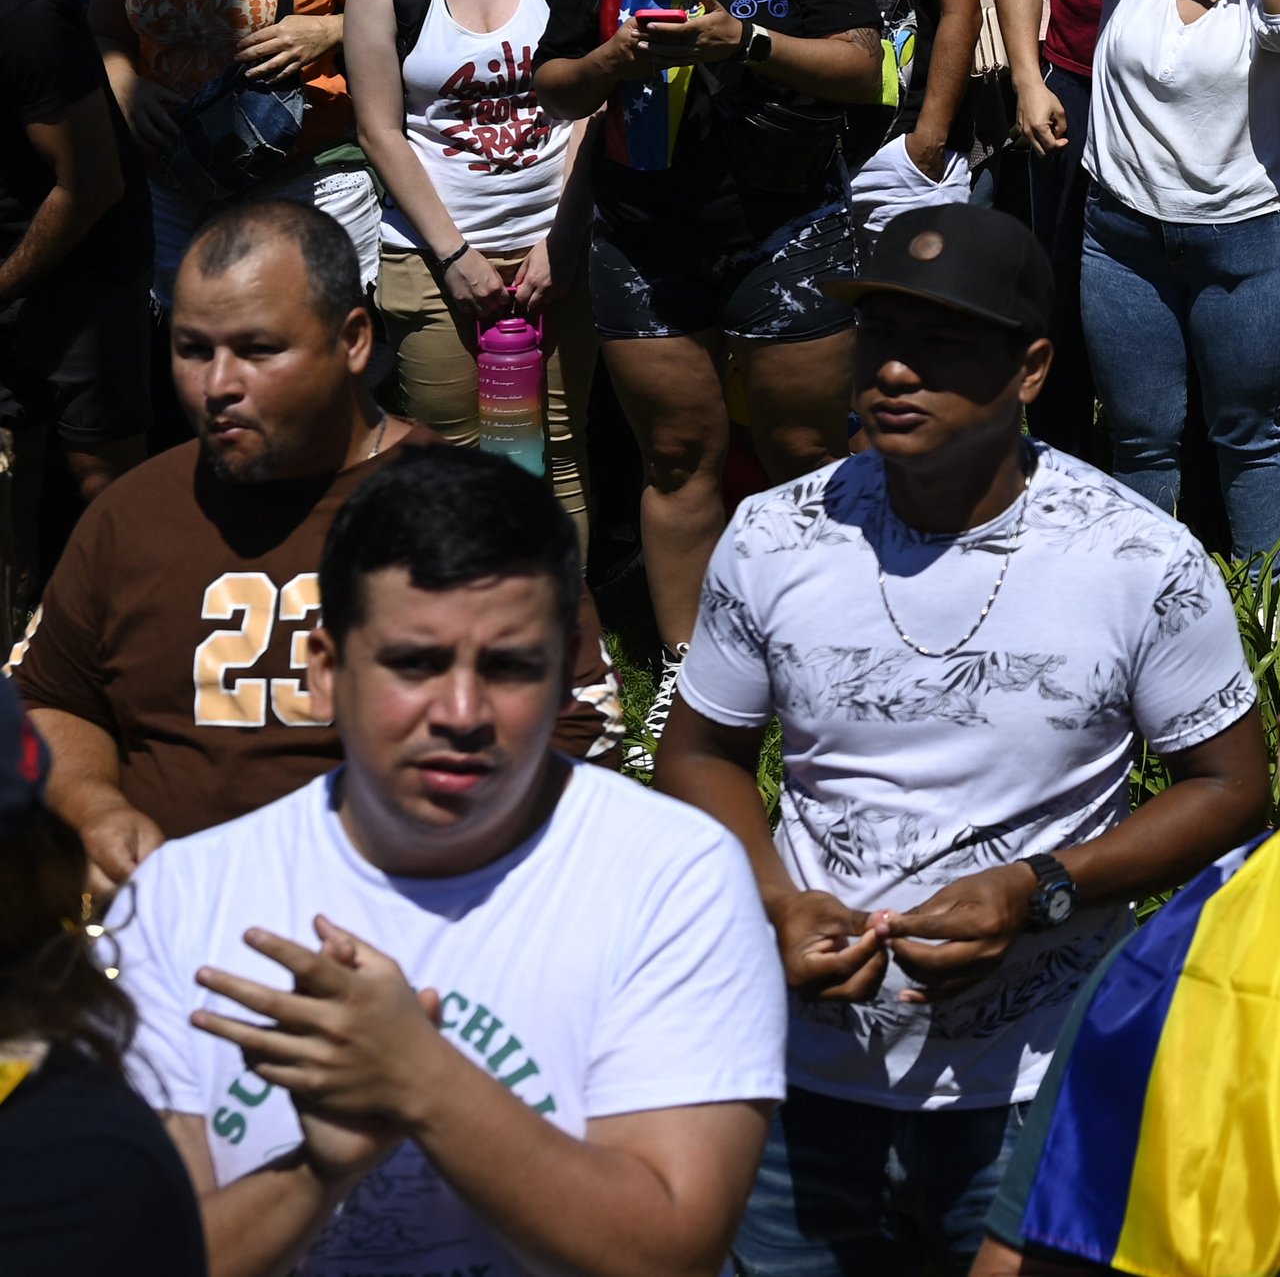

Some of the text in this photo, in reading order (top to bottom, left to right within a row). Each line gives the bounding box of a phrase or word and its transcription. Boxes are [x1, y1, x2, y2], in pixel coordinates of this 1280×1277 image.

[446, 90, 538, 126] FROM
[440, 112, 551, 159] SCRATCH
[193, 572, 333, 727] 23
